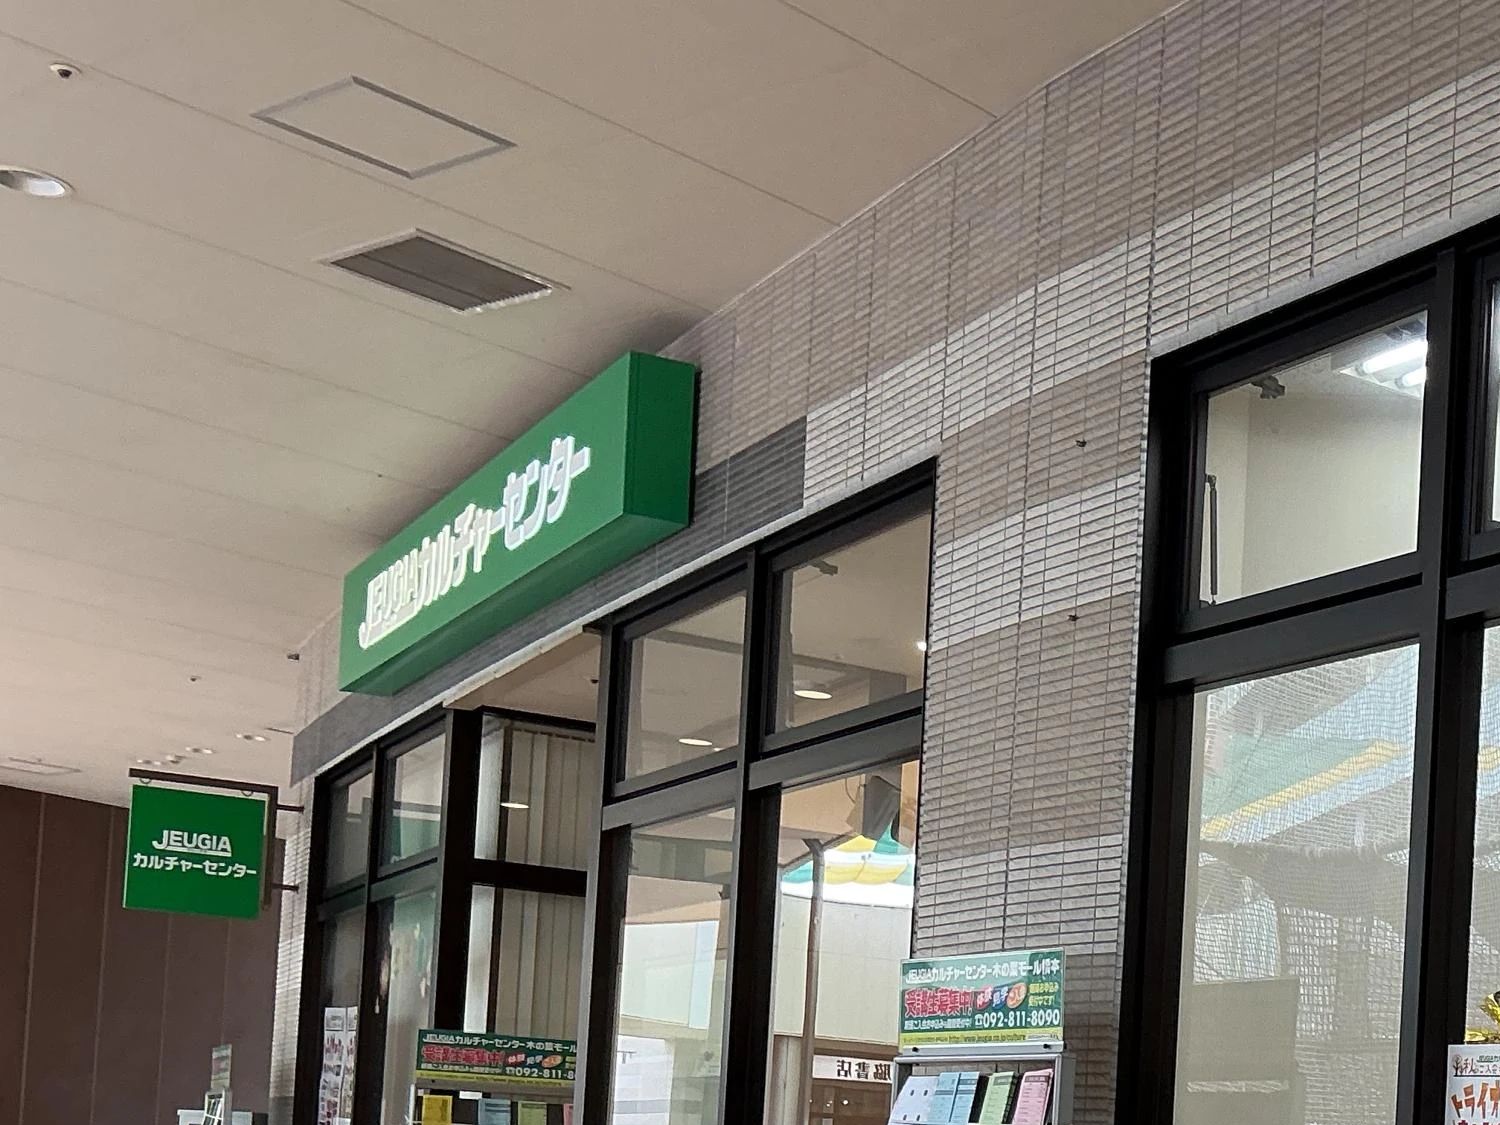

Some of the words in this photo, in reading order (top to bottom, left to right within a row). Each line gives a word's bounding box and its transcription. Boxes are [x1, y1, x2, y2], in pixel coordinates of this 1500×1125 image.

[359, 435, 590, 649] JEUGIAカルチャーセンター
[152, 829, 232, 857] JEUGIA
[132, 853, 257, 878] カルチャーセンター
[983, 1009, 1060, 1028] 092-811-8090
